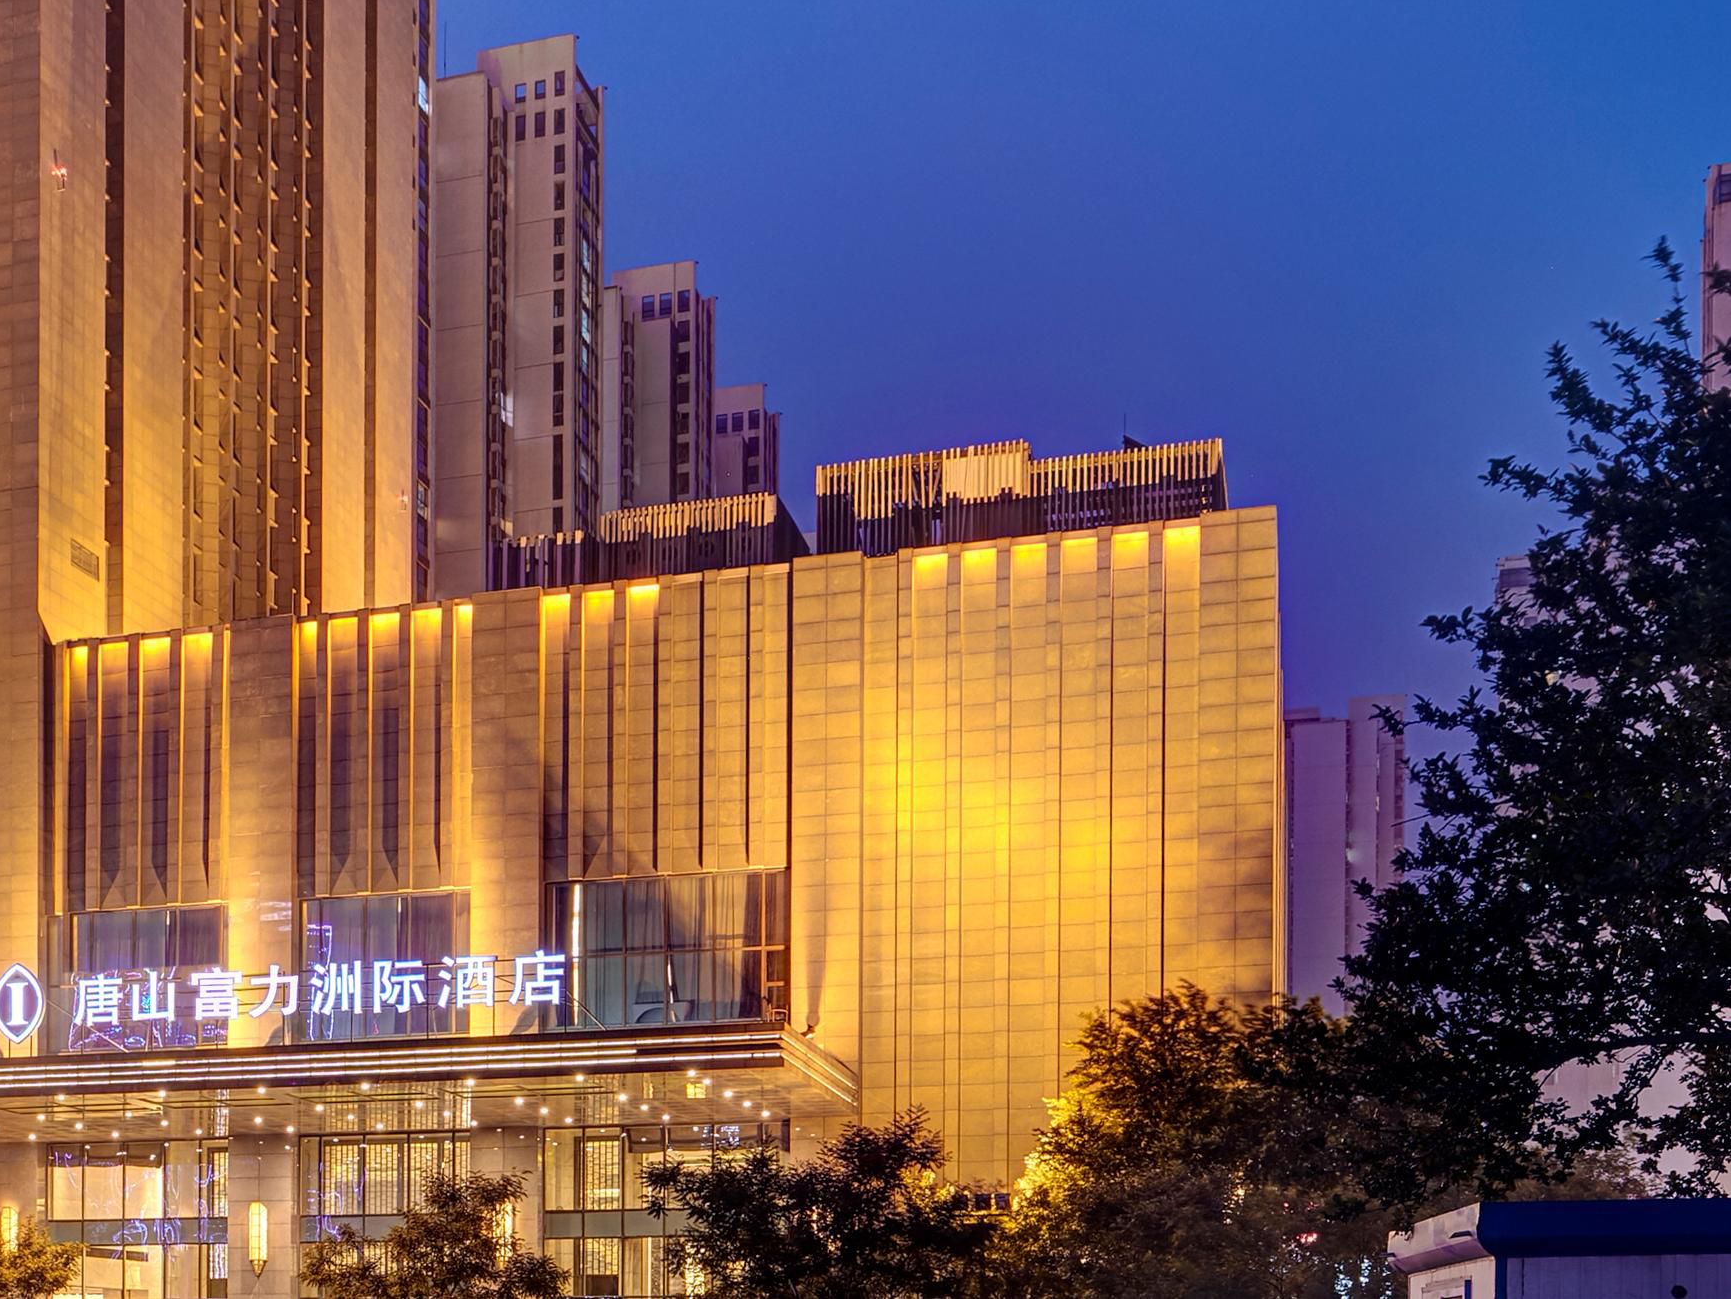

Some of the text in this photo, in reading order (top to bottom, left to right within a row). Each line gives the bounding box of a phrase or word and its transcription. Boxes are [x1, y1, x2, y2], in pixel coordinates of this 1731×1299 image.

[73, 949, 565, 1027] 唐山富力洲际酒店
